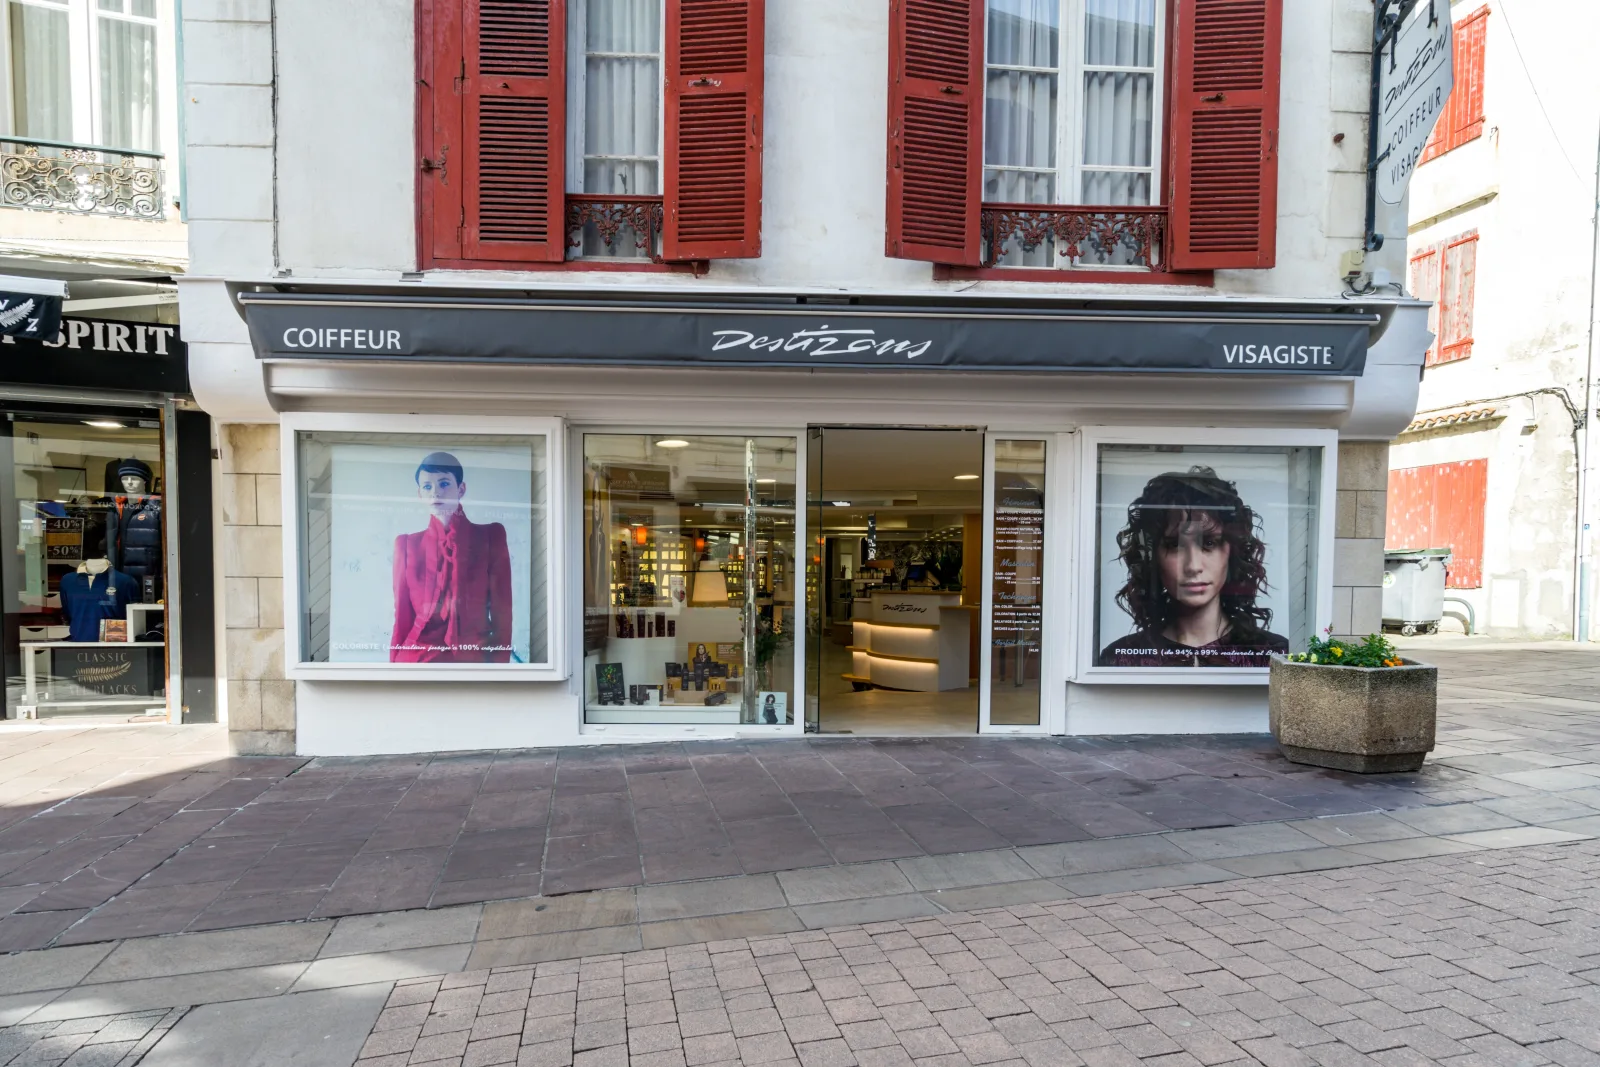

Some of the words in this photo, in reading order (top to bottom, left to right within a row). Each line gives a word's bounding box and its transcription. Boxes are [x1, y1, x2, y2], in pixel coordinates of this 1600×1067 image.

[1391, 86, 1442, 151] COIFFEUR
[283, 327, 402, 350] COIFFEUR
[1222, 344, 1333, 365] VISAGISTE
[77, 652, 127, 663] CLASSIC
[1114, 647, 1159, 655] PRODUITS
